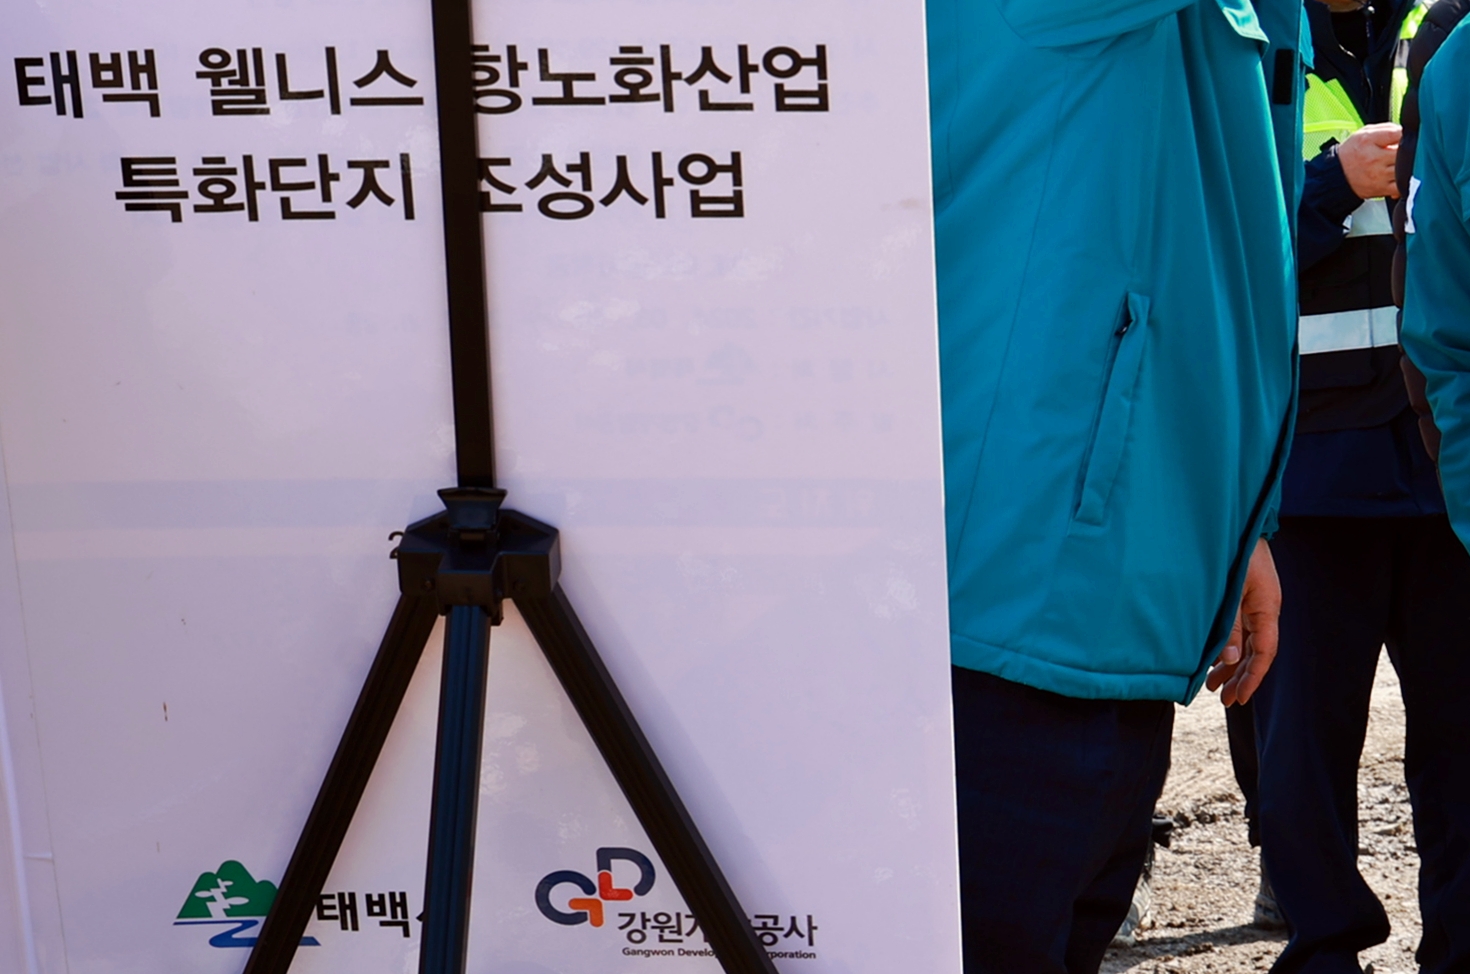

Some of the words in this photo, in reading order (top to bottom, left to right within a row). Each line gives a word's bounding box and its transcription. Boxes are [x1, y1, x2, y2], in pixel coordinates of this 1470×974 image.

[14, 49, 162, 119] 태백
[195, 46, 424, 116] 웰니스
[471, 43, 830, 115] 항노화산업
[114, 152, 416, 223] 특화단지
[478, 151, 745, 221] 조성사업
[317, 891, 424, 938] 태백
[617, 912, 818, 947] 강원공사
[622, 947, 675, 958] Gangwon
